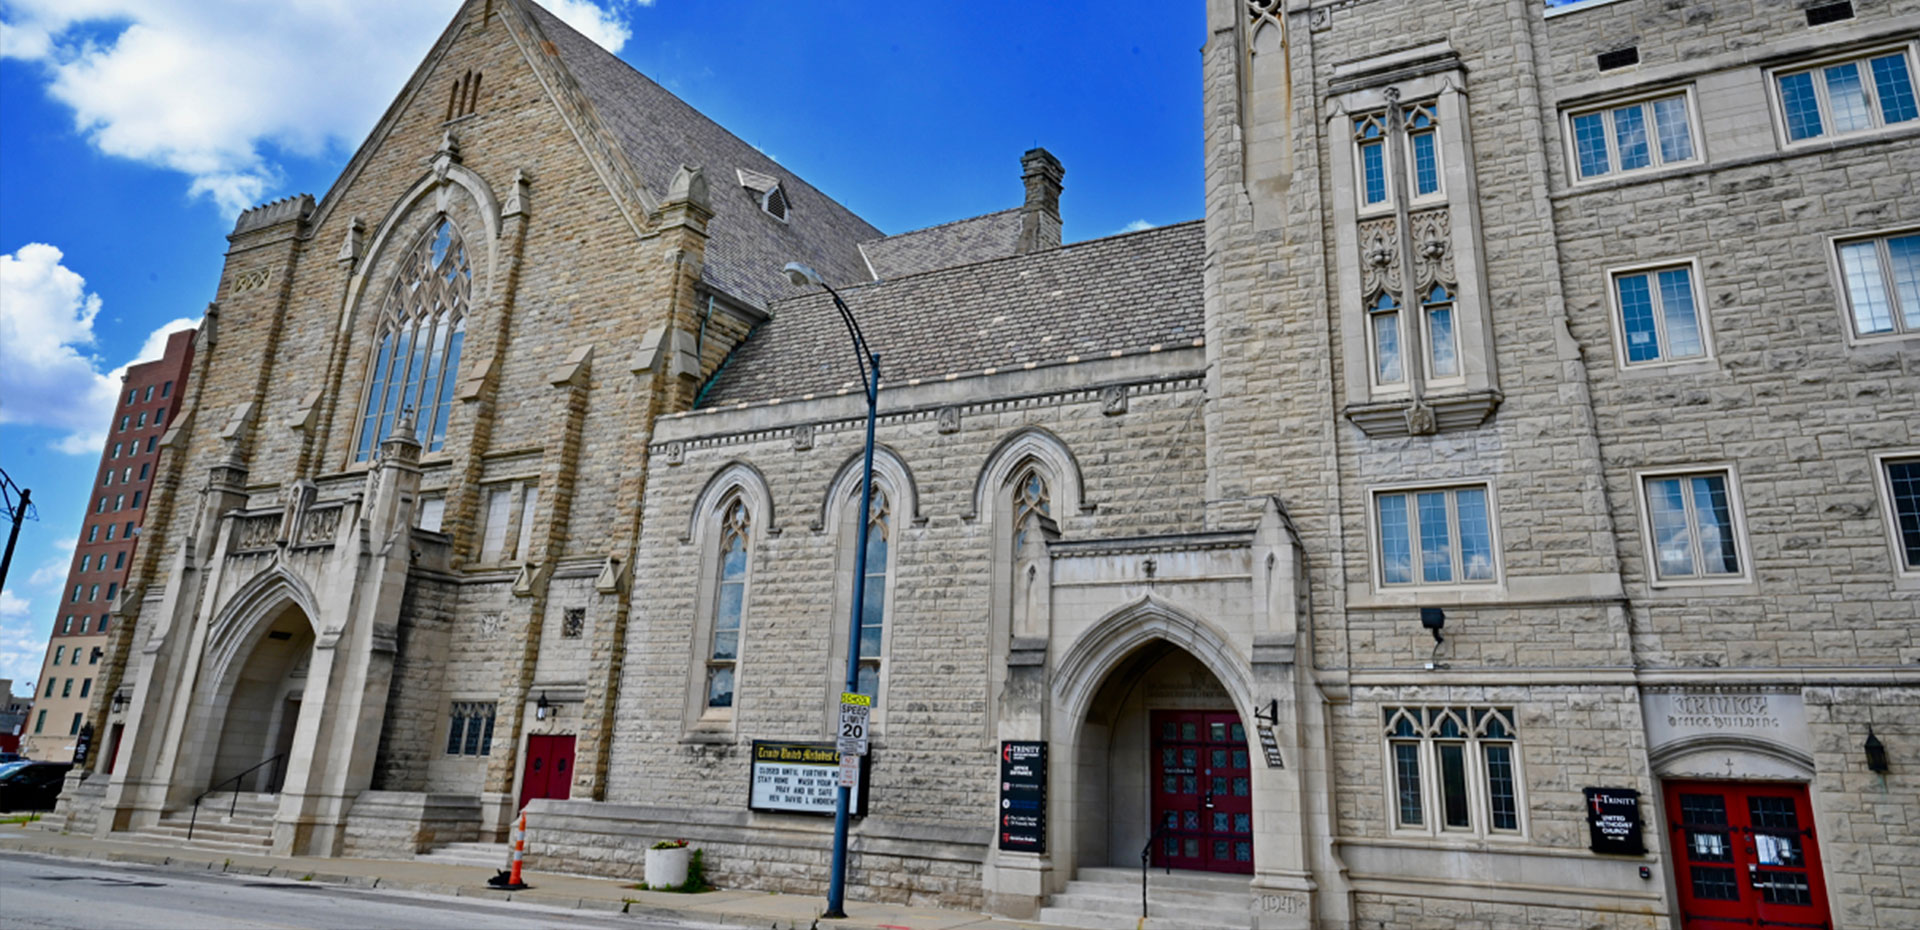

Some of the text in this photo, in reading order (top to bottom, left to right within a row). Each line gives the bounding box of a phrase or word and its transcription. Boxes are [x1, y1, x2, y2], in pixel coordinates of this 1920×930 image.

[842, 704, 868, 716] SPEED
[842, 715, 865, 724] LIMIT
[842, 723, 863, 738] 20
[759, 767, 780, 775] CLOSED
[782, 768, 799, 776] UNTIL
[802, 769, 828, 777] FURTHER
[798, 778, 814, 786] WASH
[818, 788, 833, 796] SAFE
[785, 795, 802, 804] DAVID
[1596, 820, 1633, 828] METHODIST
[1262, 894, 1297, 914] 1941
